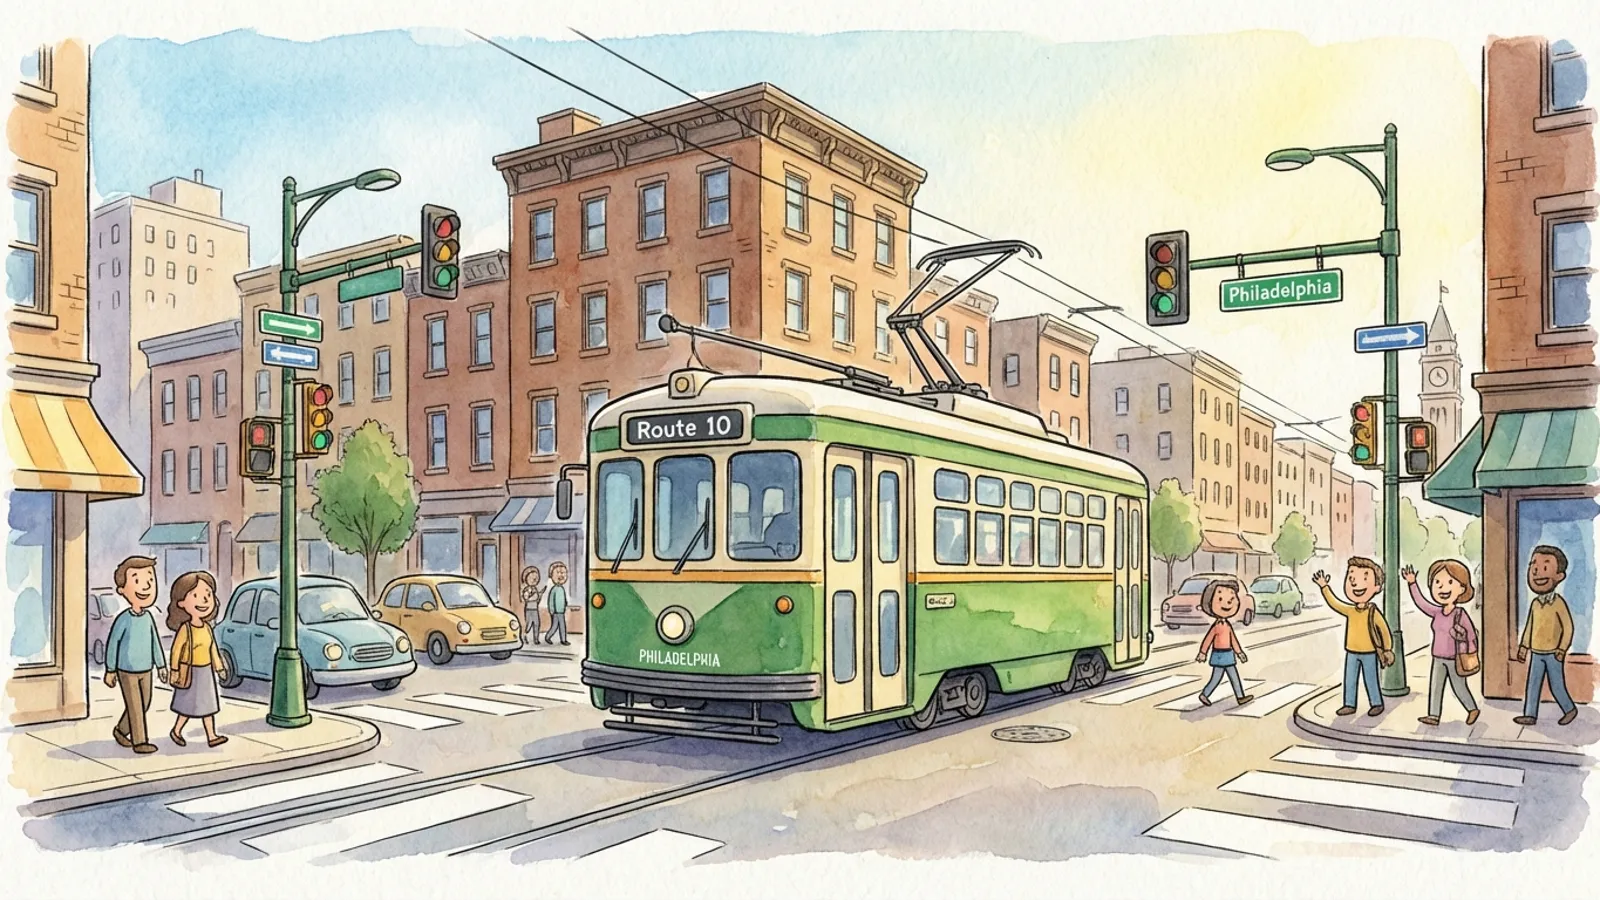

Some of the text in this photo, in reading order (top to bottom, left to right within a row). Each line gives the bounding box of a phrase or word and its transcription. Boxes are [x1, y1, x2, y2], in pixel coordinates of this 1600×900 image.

[1229, 279, 1332, 302] Philadelphia
[637, 415, 731, 439] Route 10
